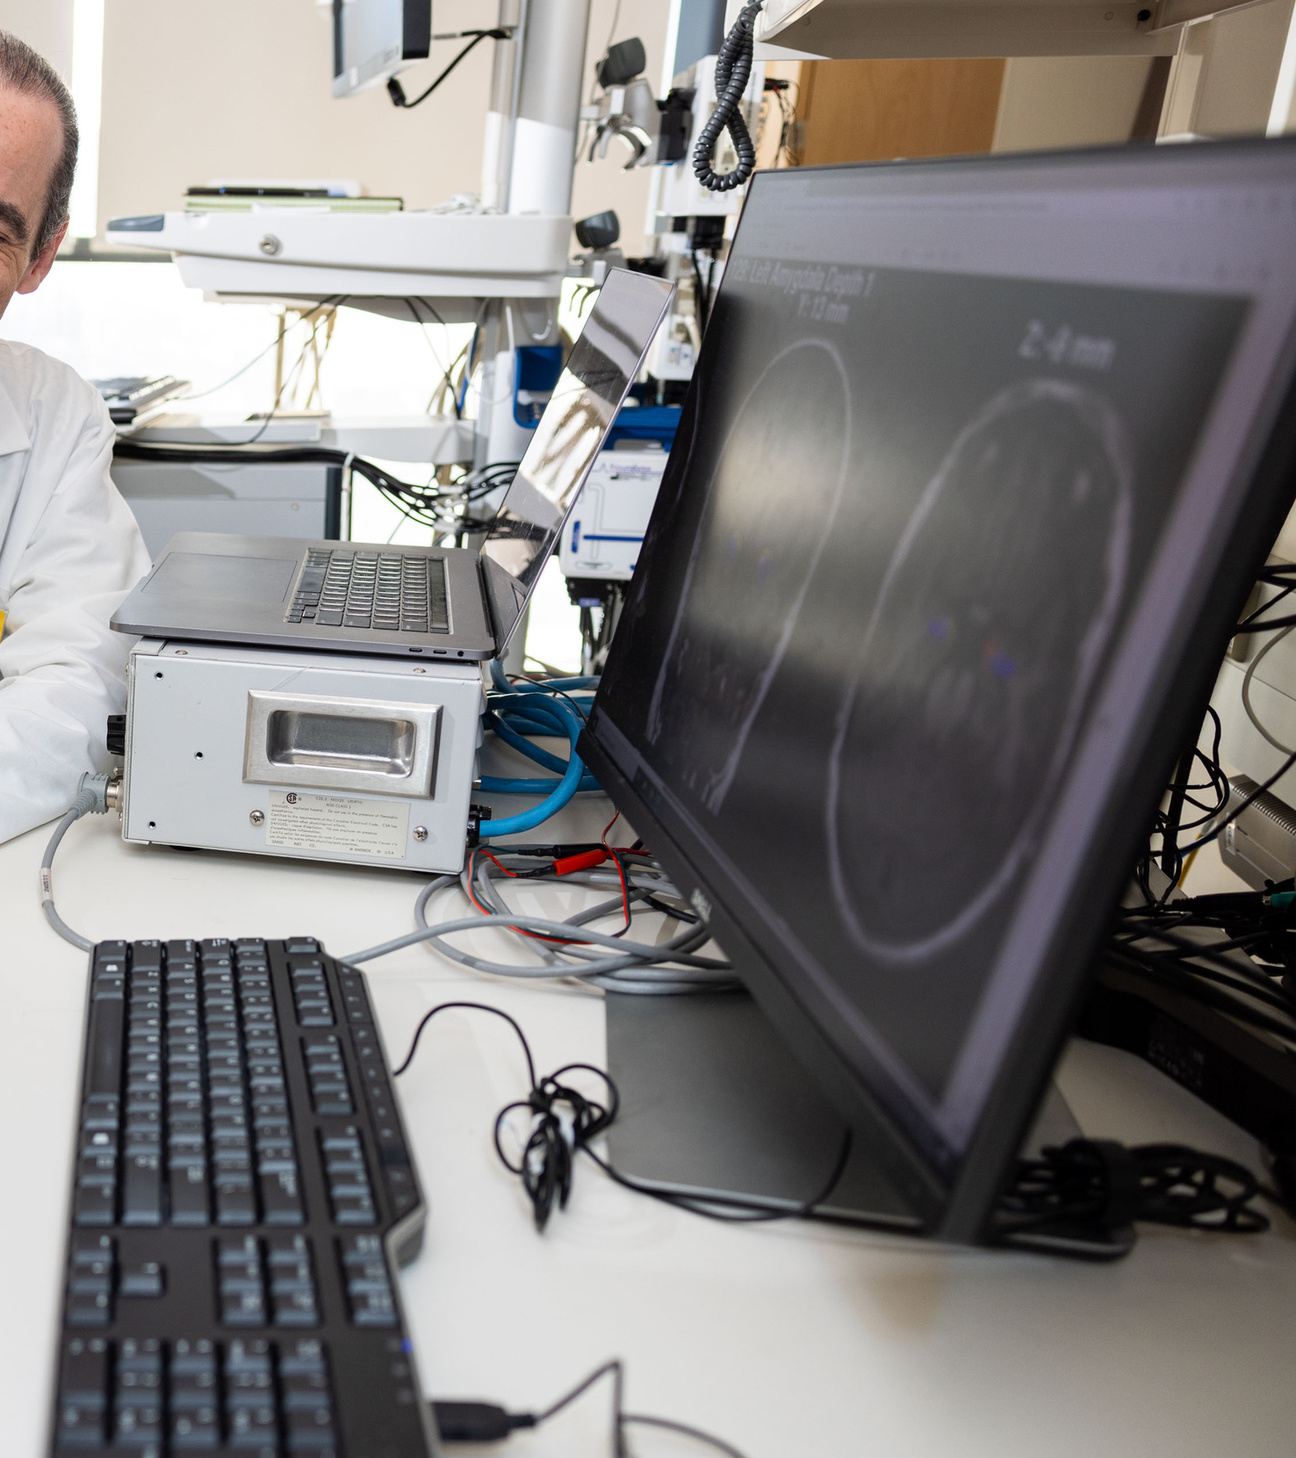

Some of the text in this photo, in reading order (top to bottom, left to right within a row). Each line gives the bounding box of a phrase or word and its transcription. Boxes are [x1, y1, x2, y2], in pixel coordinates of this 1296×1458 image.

[749, 259, 772, 284] Left
[825, 301, 850, 323] mm
[1071, 336, 1117, 370] mm
